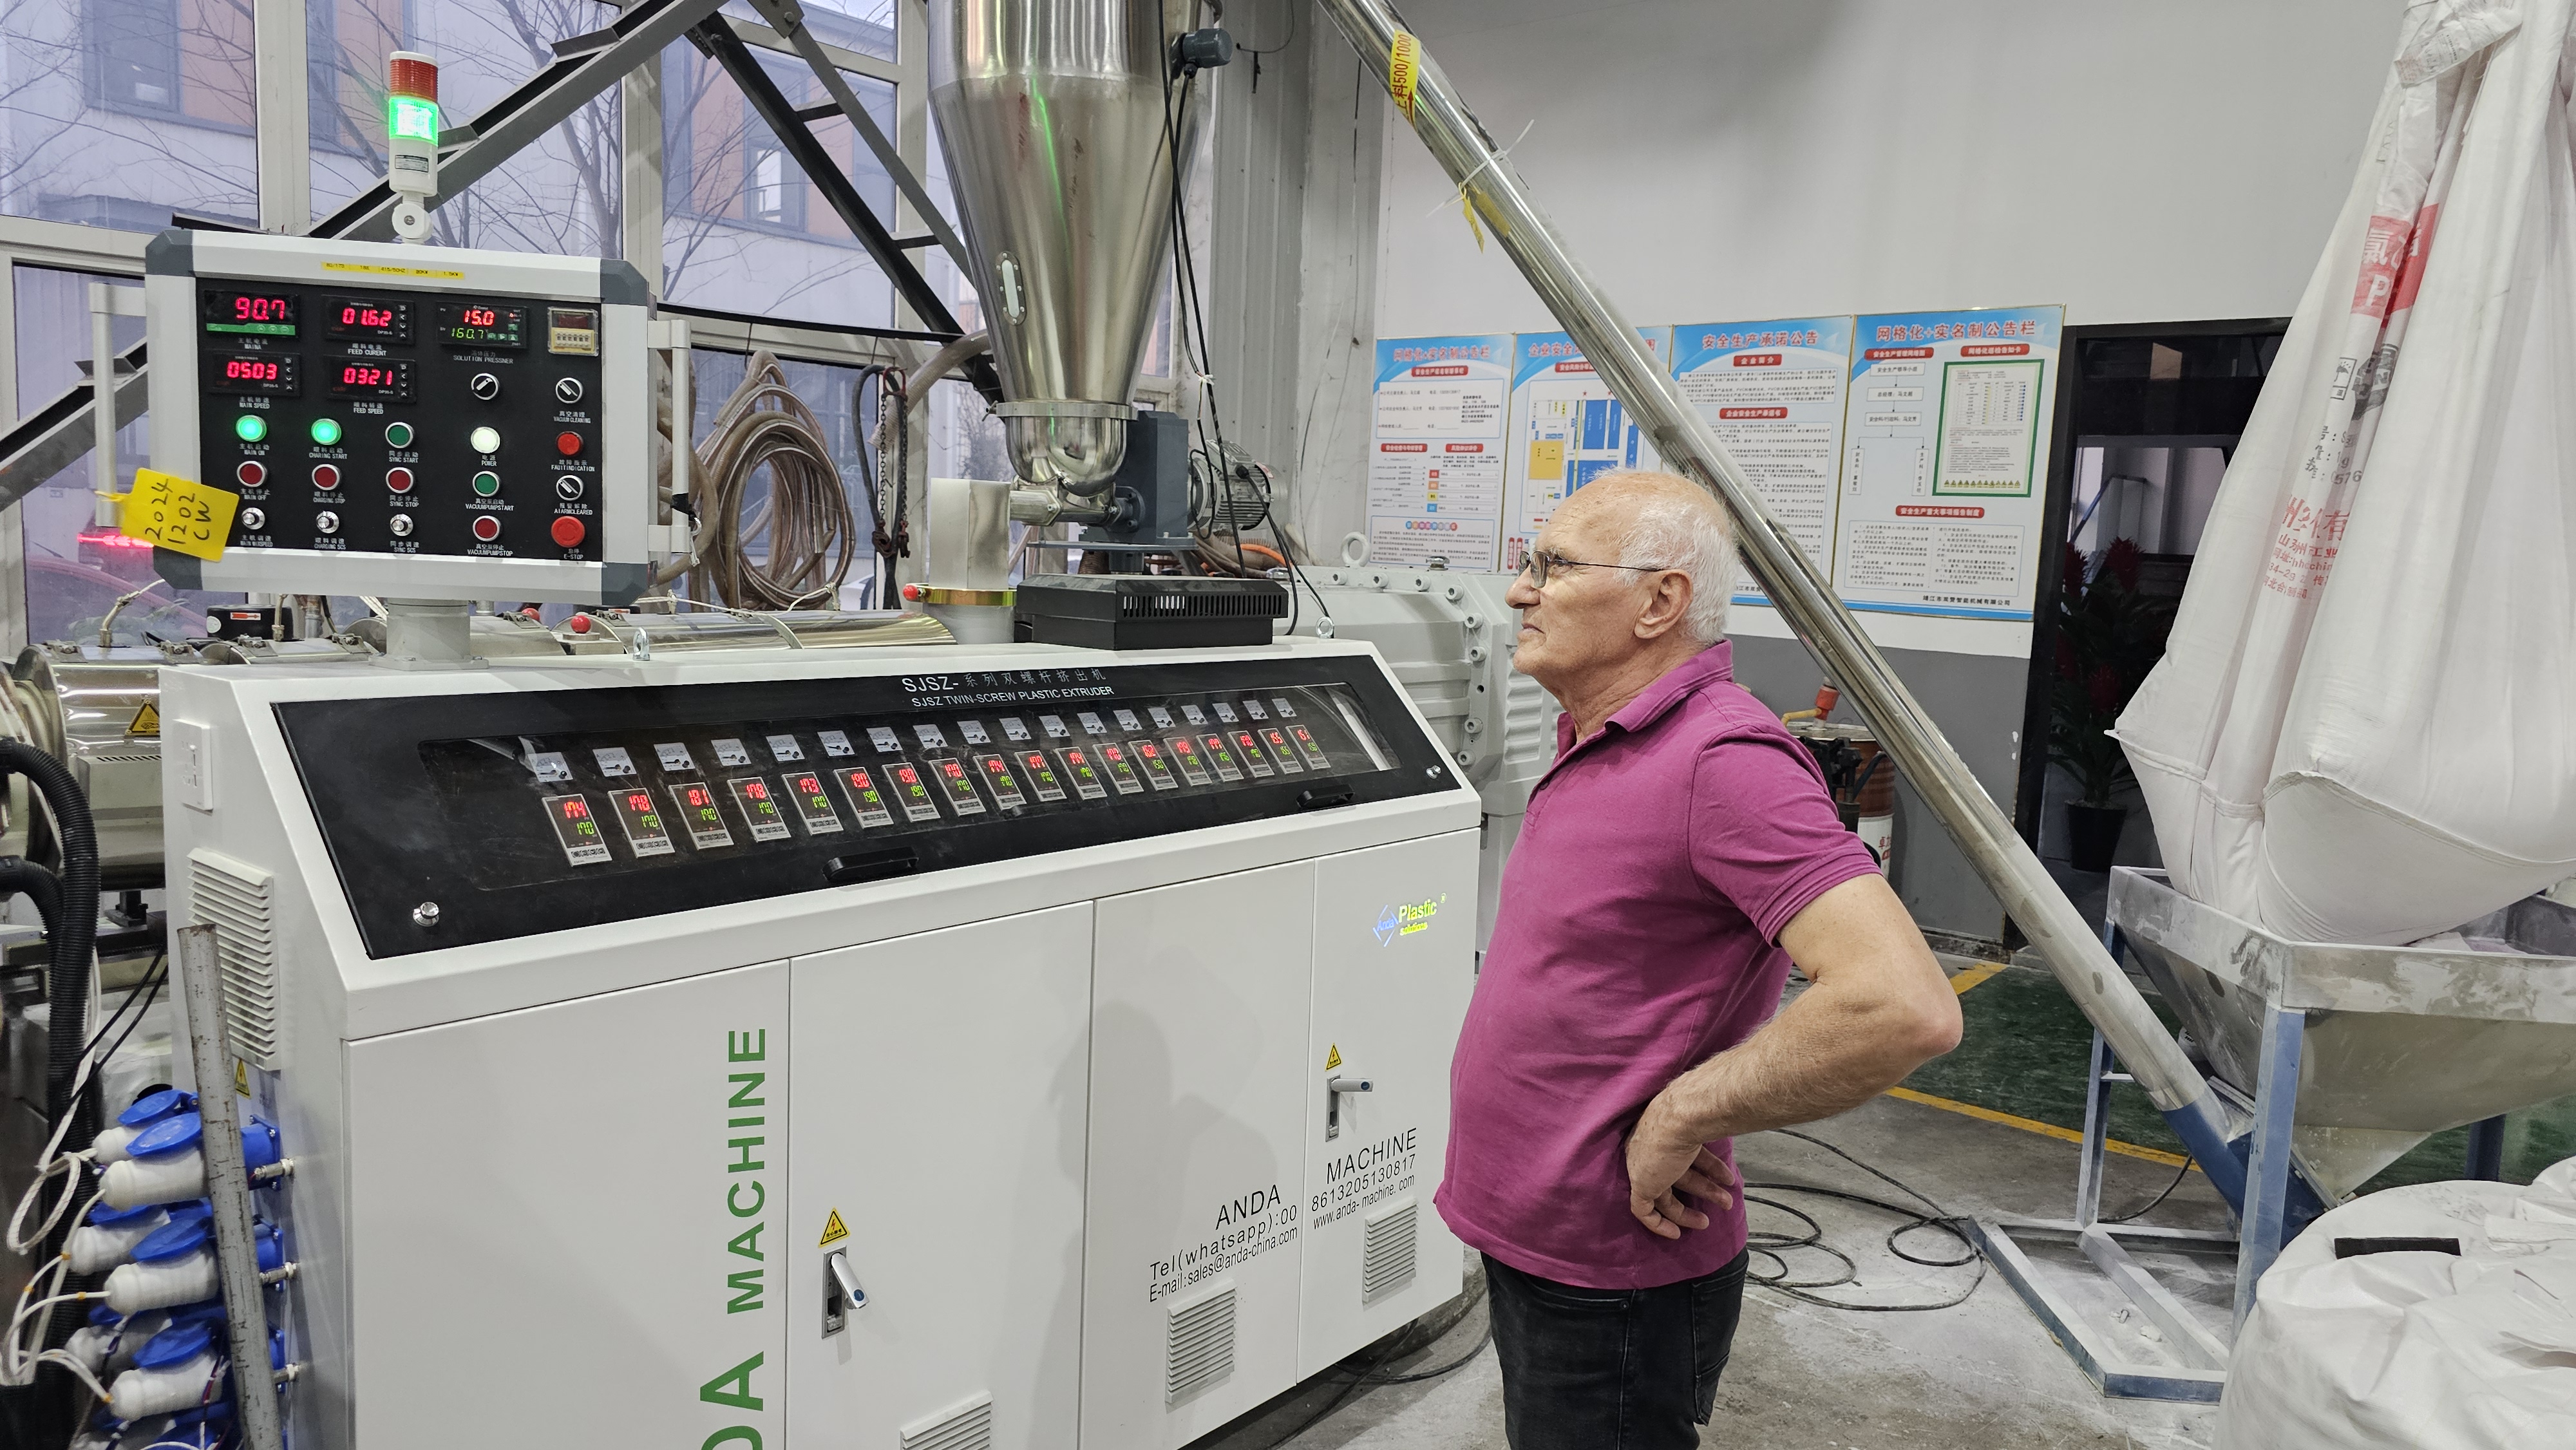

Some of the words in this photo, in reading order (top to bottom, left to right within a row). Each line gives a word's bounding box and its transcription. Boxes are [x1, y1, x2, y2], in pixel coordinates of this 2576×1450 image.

[1702, 330, 1819, 349] 安全生产承诺公告
[1876, 320, 2036, 342] 网格化+实名制公告栏
[227, 361, 278, 381] 0503
[343, 367, 393, 386] 0321
[902, 676, 958, 693] SJSZ-
[965, 668, 1106, 688] 系列双螺杆挤出机
[911, 697, 943, 707] SJSZ
[943, 692, 1016, 705] TWIN-SCREW
[1018, 690, 1060, 700] PLASTIC
[1061, 686, 1115, 697] EXTRUDER
[863, 790, 878, 803] 190
[911, 785, 925, 796] 190
[641, 814, 658, 828] 170
[700, 807, 717, 822] 170
[576, 821, 594, 835] 170
[1398, 899, 1437, 923] Plastic
[727, 1028, 766, 1315] MACHINE
[1216, 1184, 1281, 1230] ANDA
[1327, 1127, 1417, 1184] MACHINE
[1311, 1153, 1416, 1212] 8613205130817
[1150, 1227, 1298, 1303] E-mail:sales@anda-china.com
